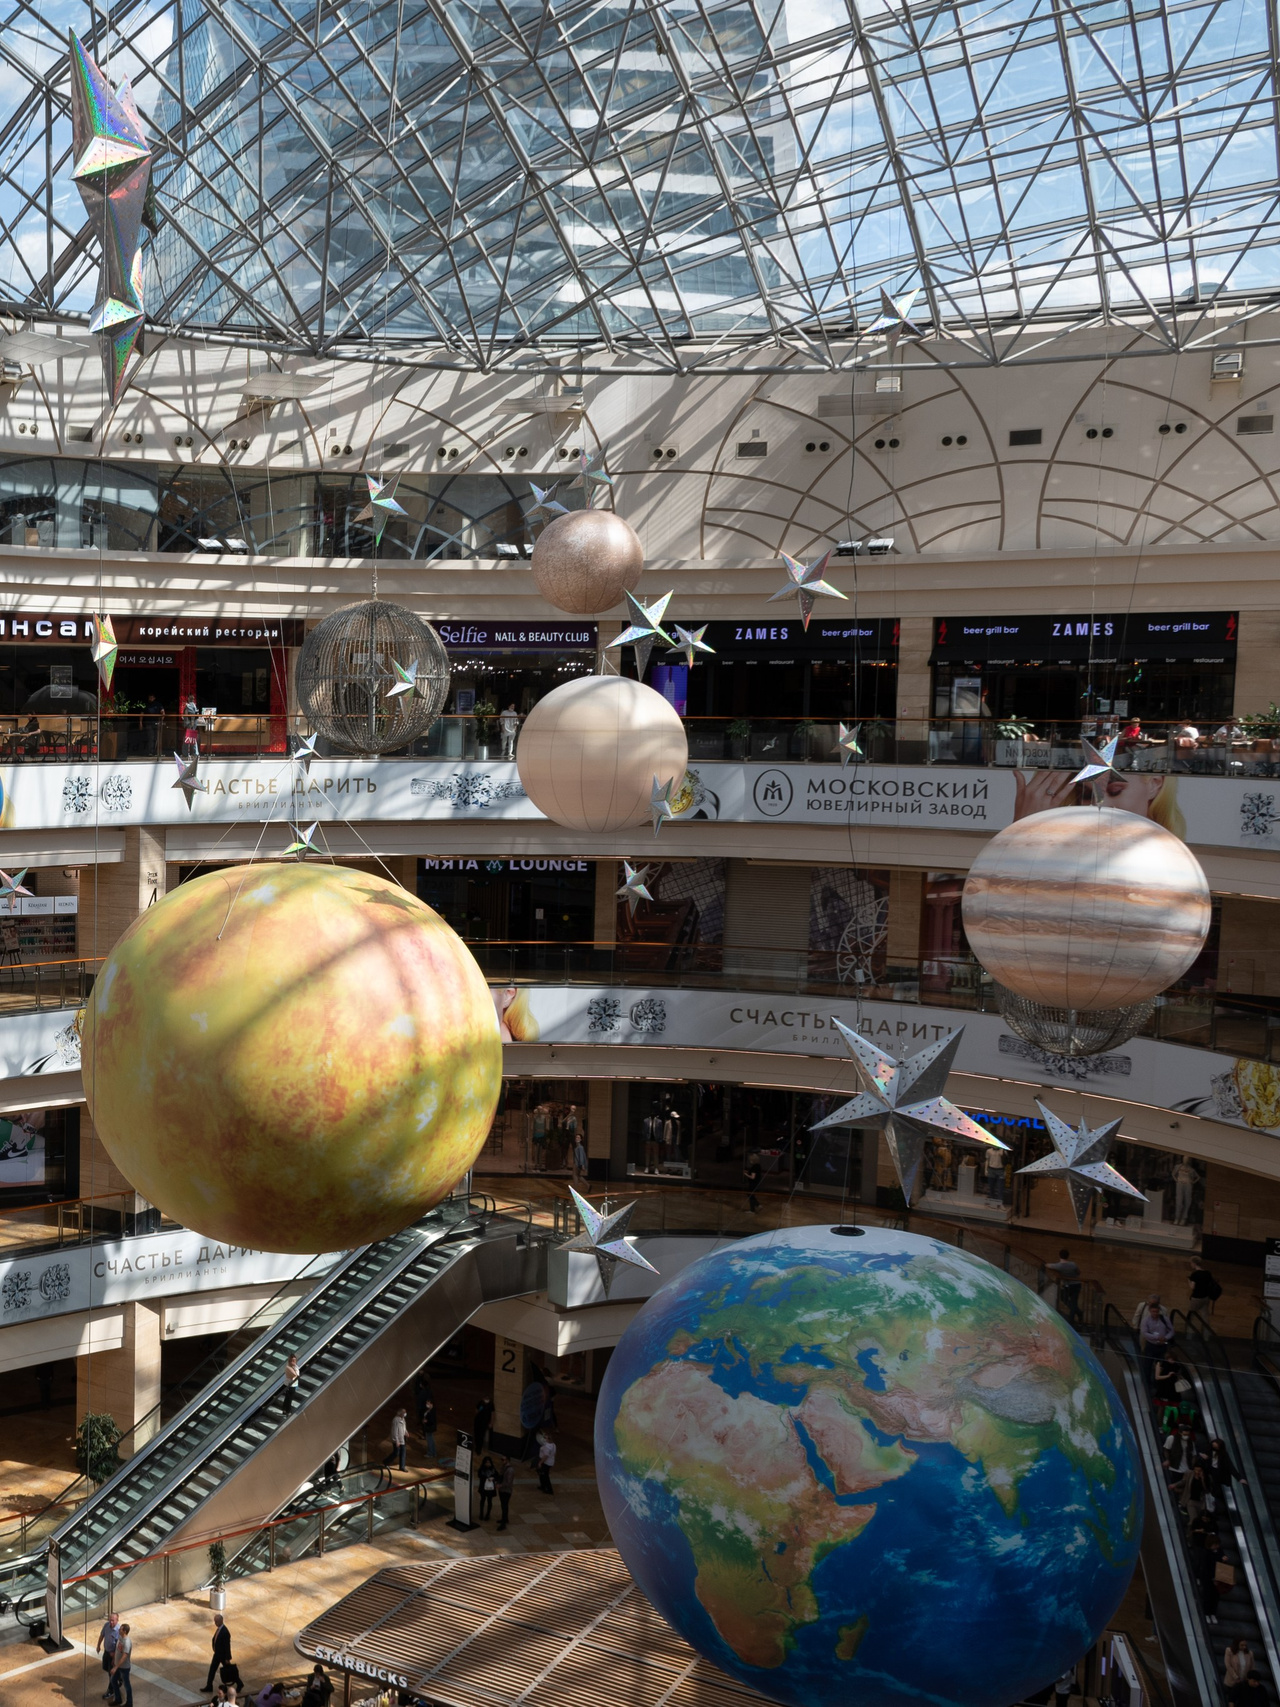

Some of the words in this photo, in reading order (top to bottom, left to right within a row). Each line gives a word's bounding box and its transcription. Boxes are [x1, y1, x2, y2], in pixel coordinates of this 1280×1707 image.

[139, 626, 209, 638] корейский
[215, 628, 279, 640] ресторан
[439, 625, 487, 643] Selfie
[735, 627, 789, 640] ZAMES
[822, 629, 840, 637] beer
[842, 629, 858, 638] grill
[859, 629, 873, 637] bar
[963, 626, 984, 634] beer
[985, 626, 1002, 636] grill
[1003, 626, 1019, 634] bar
[1052, 622, 1114, 636] ZAMES
[1147, 623, 1170, 632] beer
[1172, 622, 1191, 633] grill
[1192, 622, 1210, 631] bar
[494, 632, 517, 642] NAIL
[518, 632, 526, 642] &
[528, 632, 565, 642] BEAUTY
[565, 632, 590, 642] CLUB
[193, 778, 278, 796] ЧАСТЬЕ
[291, 777, 378, 796] ДАРИТЬ
[806, 777, 989, 801] МОСКОВСКИЙ
[238, 801, 323, 809] БРИЛЛИАНТЫ
[806, 798, 923, 815] ЮВЕЛИРНЫЙ
[928, 798, 987, 820] ЗАВОД
[509, 859, 588, 872] LOUNGE
[730, 1007, 840, 1031] СЧАСТЬЕ
[93, 1249, 183, 1278] СЧАСТЬЕ
[144, 1266, 227, 1285] БРИЛЛИАНТЫ
[502, 1350, 516, 1373] 2
[461, 1434, 469, 1447] 2
[315, 1645, 408, 1688] STARBUCKS
